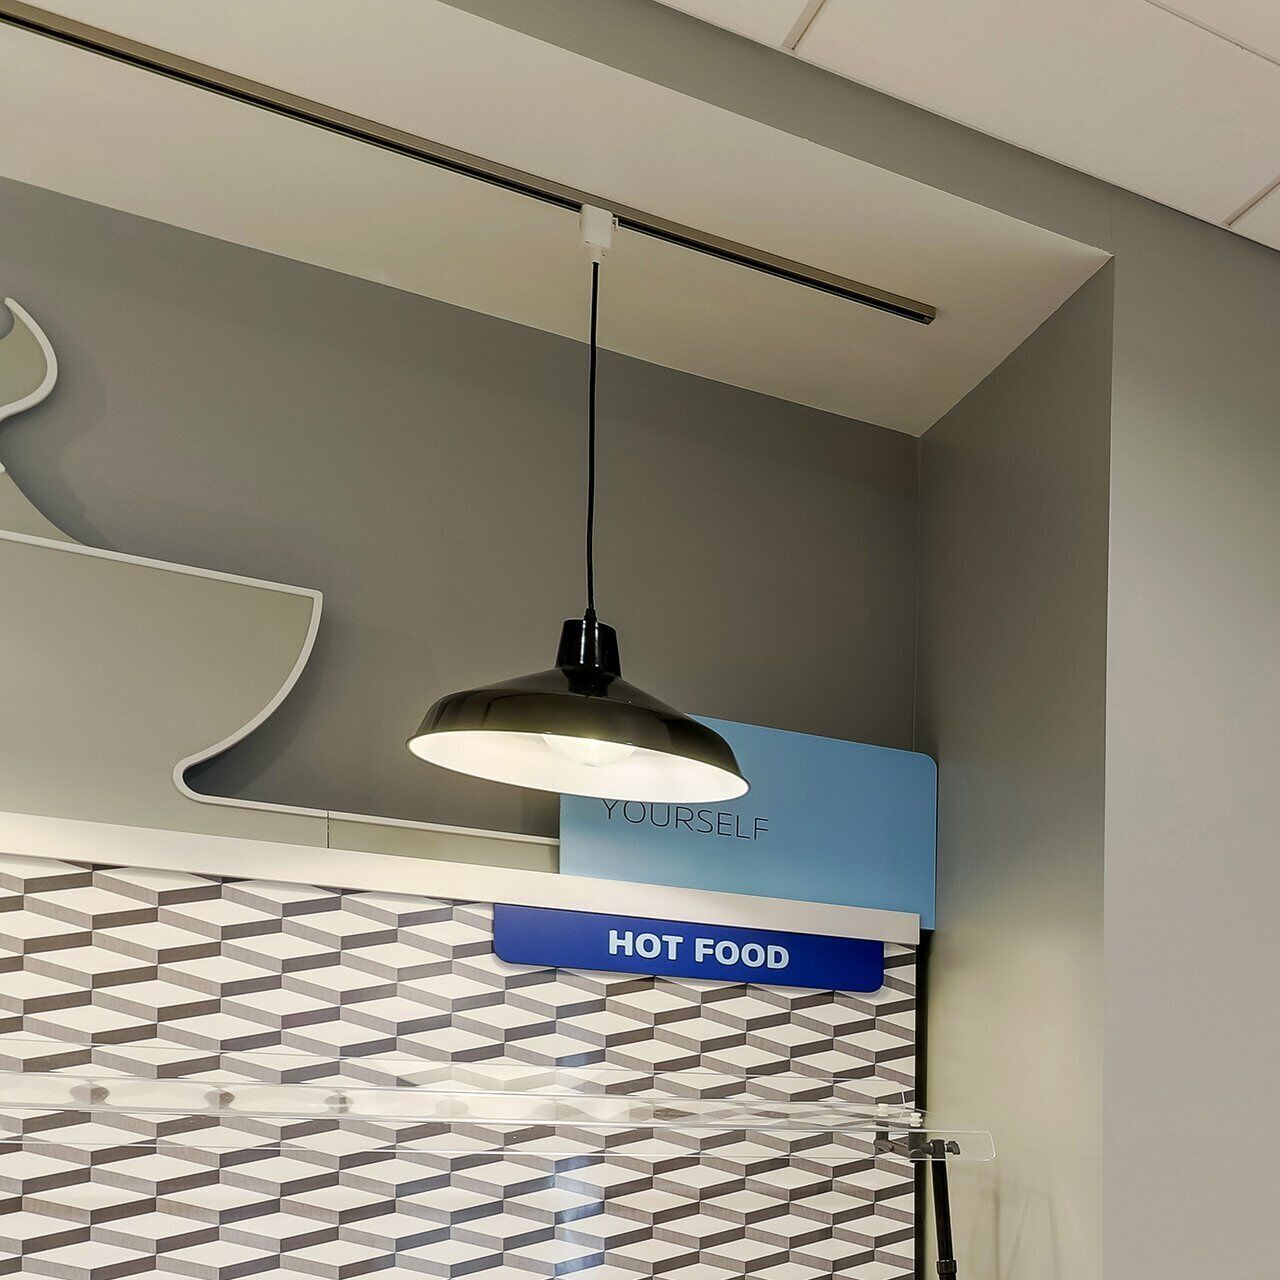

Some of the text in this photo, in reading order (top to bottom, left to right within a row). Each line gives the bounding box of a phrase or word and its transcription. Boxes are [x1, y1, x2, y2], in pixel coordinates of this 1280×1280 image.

[602, 799, 769, 840] YOURSELF
[608, 930, 790, 969] HOT FOOD
